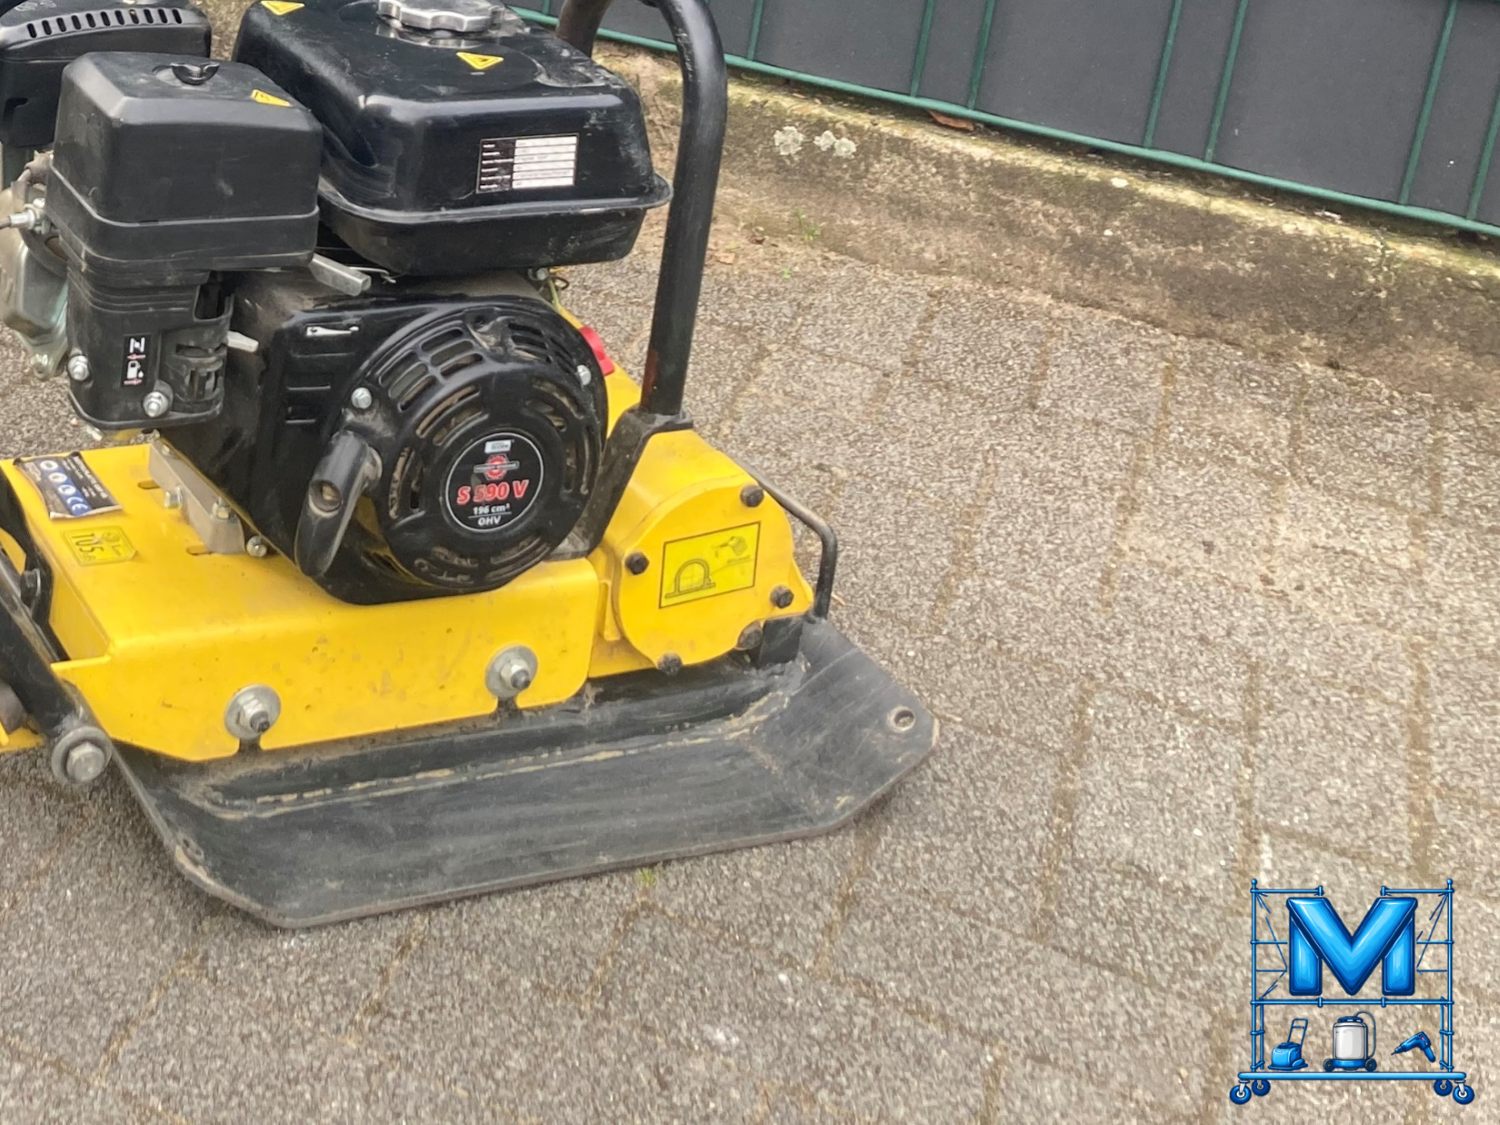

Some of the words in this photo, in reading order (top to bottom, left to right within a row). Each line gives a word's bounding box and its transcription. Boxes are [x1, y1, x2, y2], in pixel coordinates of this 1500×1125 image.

[457, 486, 471, 505] S
[473, 481, 510, 503] 590
[512, 479, 529, 498] V
[473, 505, 490, 515] 196
[477, 515, 501, 526] OHV
[71, 533, 105, 553] 105
